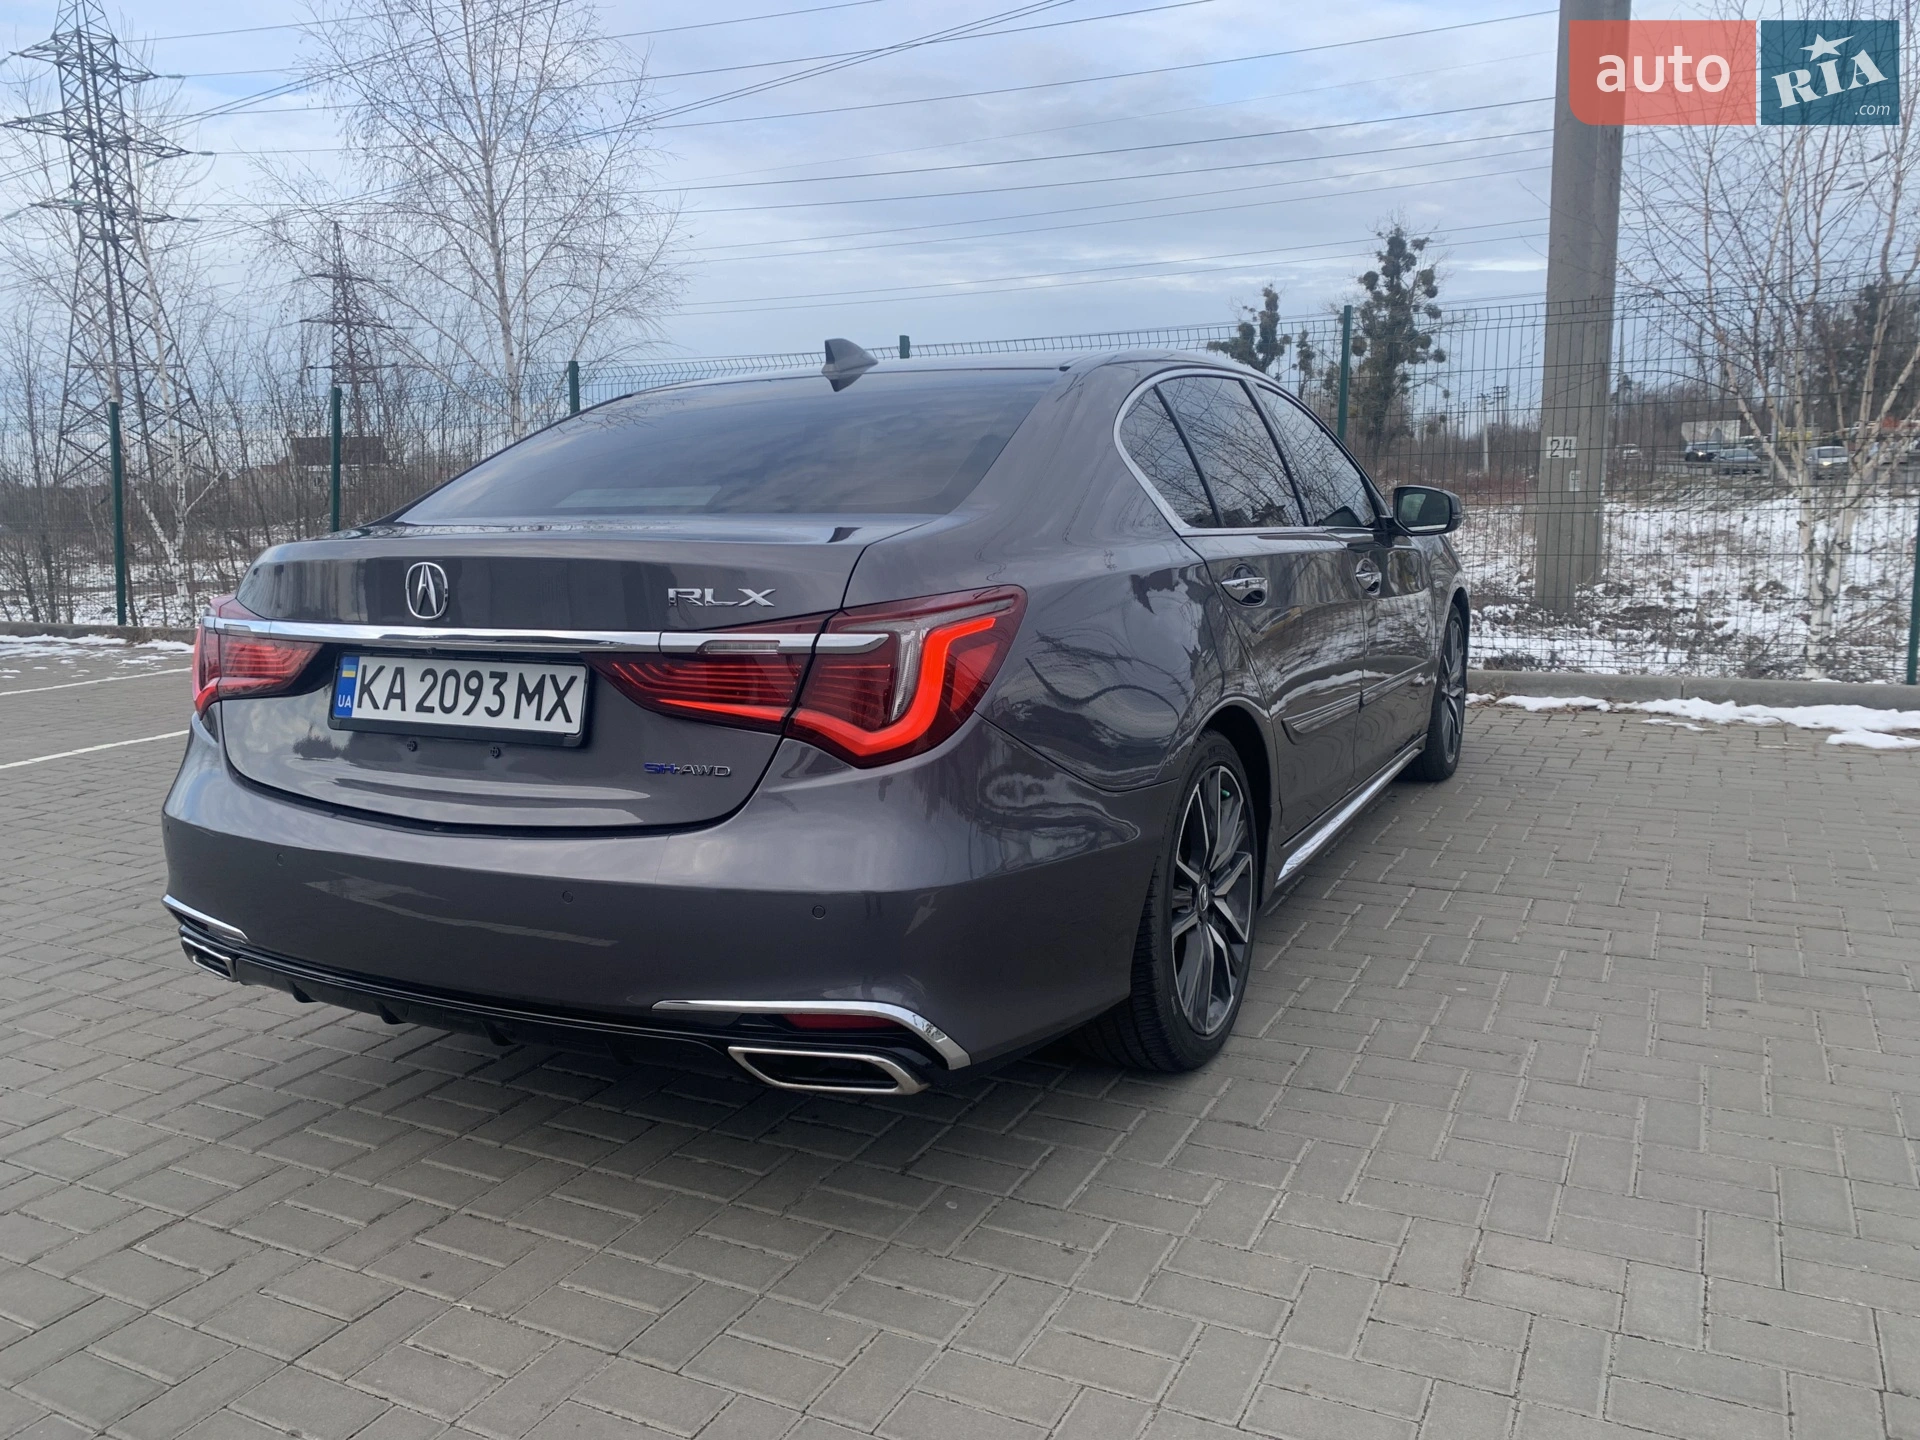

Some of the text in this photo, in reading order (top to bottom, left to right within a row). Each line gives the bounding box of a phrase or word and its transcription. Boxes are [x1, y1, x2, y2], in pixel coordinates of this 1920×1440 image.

[1550, 438, 1573, 458] 24
[667, 587, 776, 607] RLX
[337, 694, 352, 708] UA
[356, 664, 578, 724] KA 2093 MX
[643, 762, 731, 777] SH-AWD
